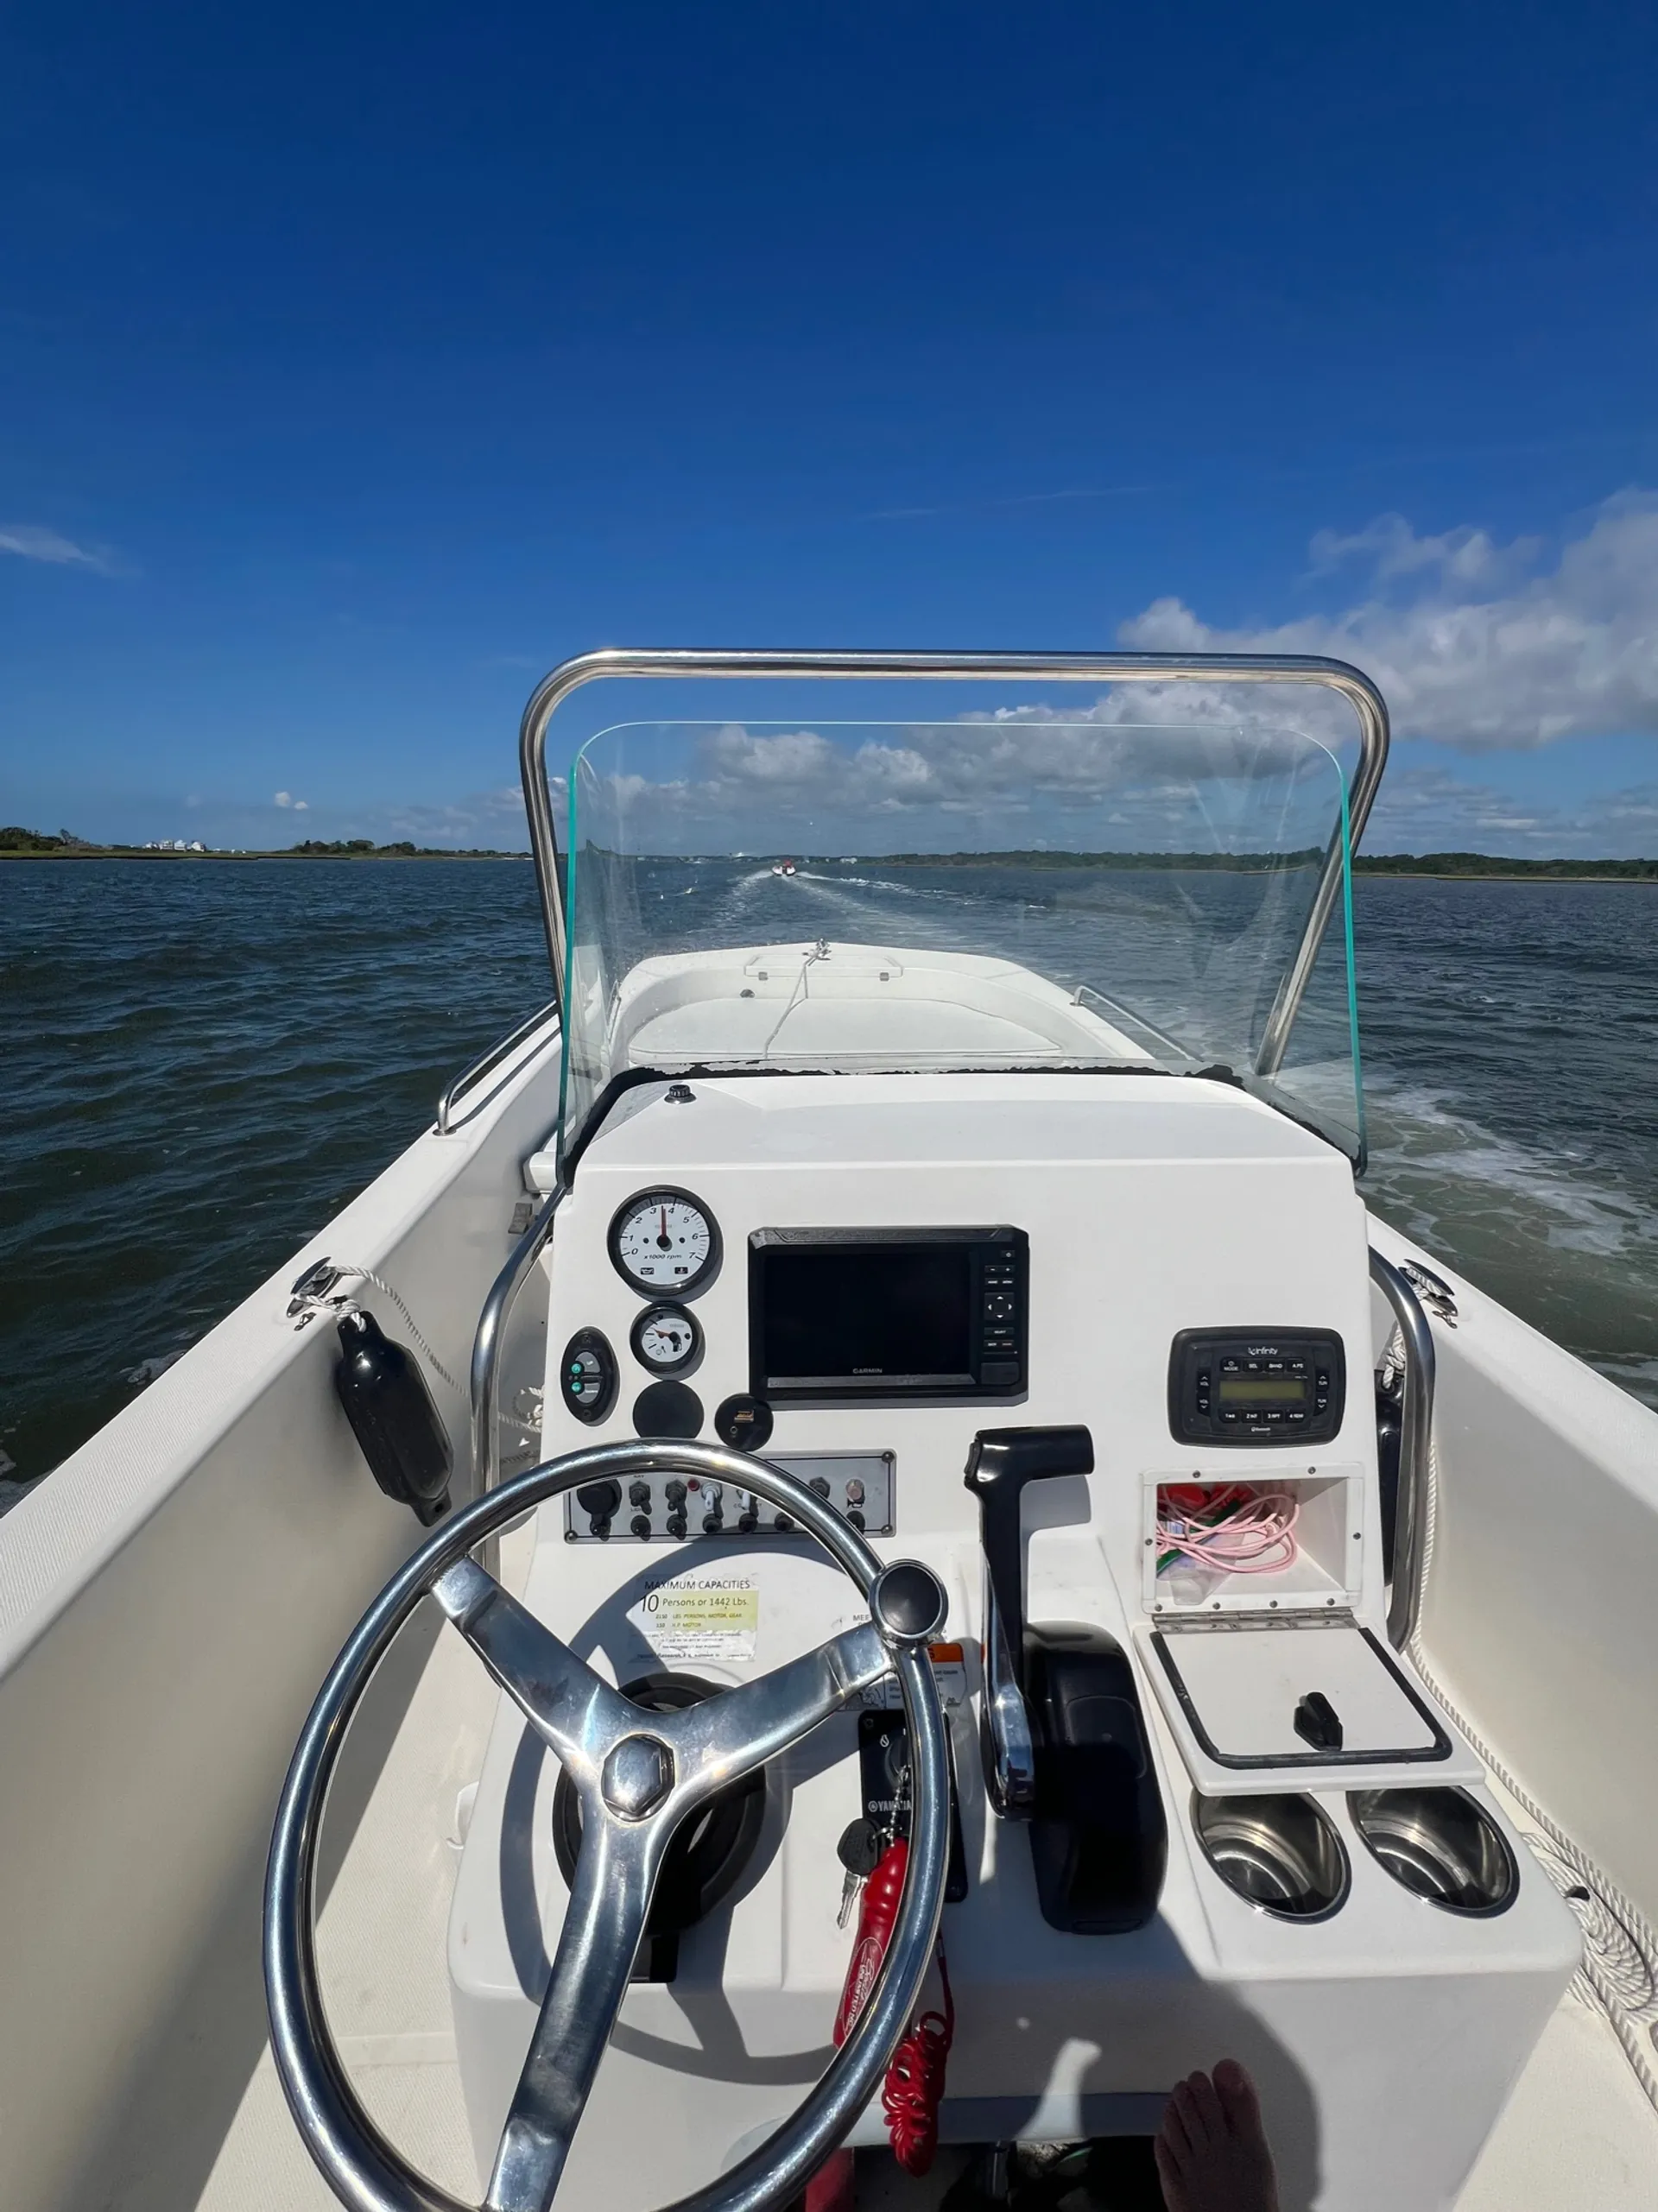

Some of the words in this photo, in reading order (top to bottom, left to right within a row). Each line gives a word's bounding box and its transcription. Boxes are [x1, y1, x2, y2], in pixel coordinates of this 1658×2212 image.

[644, 1580, 696, 1589] MAXIMUM
[698, 1580, 750, 1589] CAPACITIES
[640, 1594, 660, 1613] 10
[662, 1598, 696, 1607] Persons
[710, 1597, 731, 1606] 1442
[851, 1964, 866, 2013] UNLIMITED
